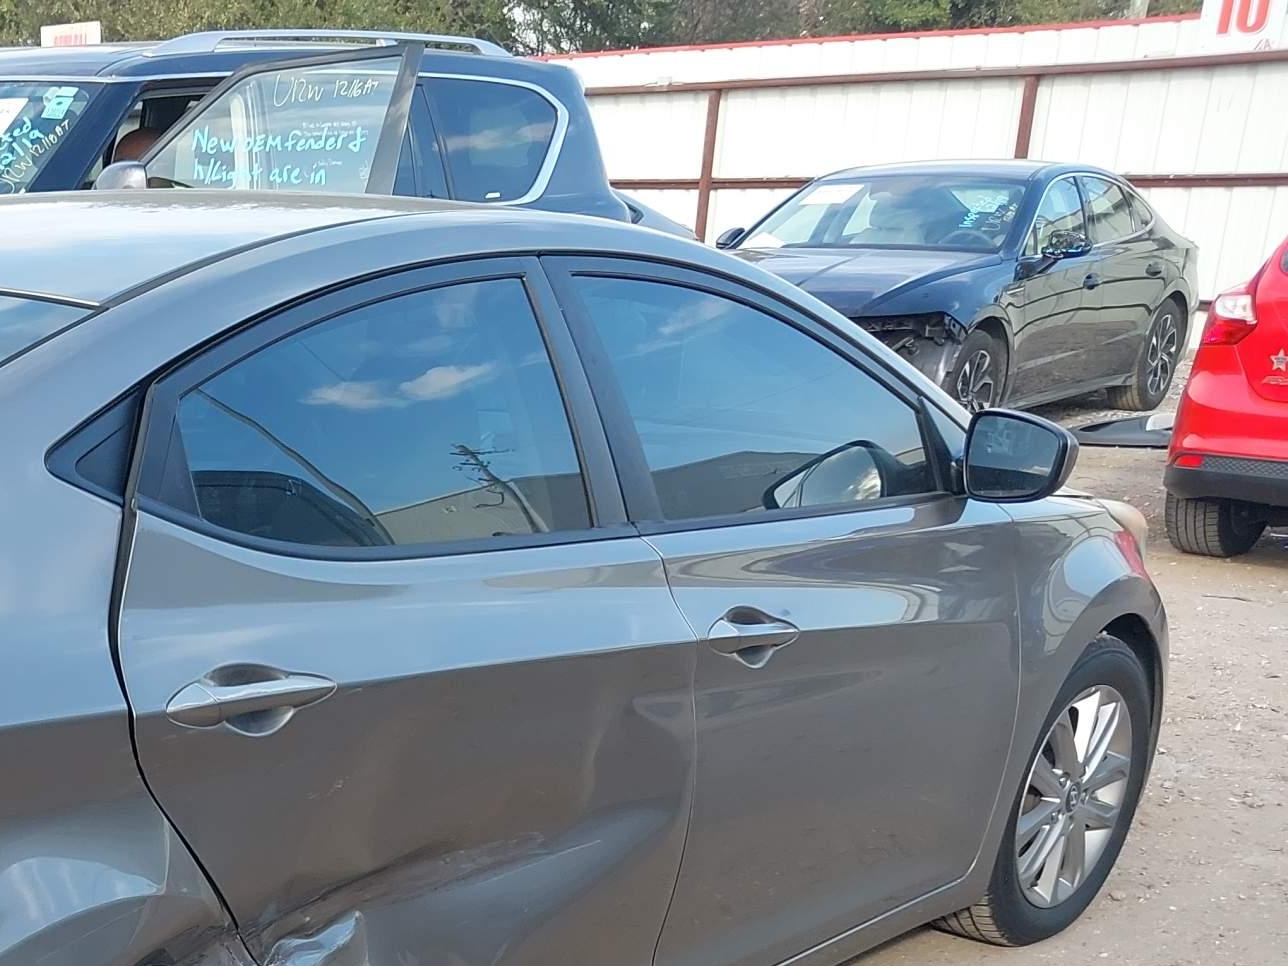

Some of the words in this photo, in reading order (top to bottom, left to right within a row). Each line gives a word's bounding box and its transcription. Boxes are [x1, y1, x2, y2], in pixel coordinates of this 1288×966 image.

[192, 126, 237, 154] New
[285, 127, 348, 152] fender
[268, 164, 302, 185] are
[309, 162, 327, 185] in
